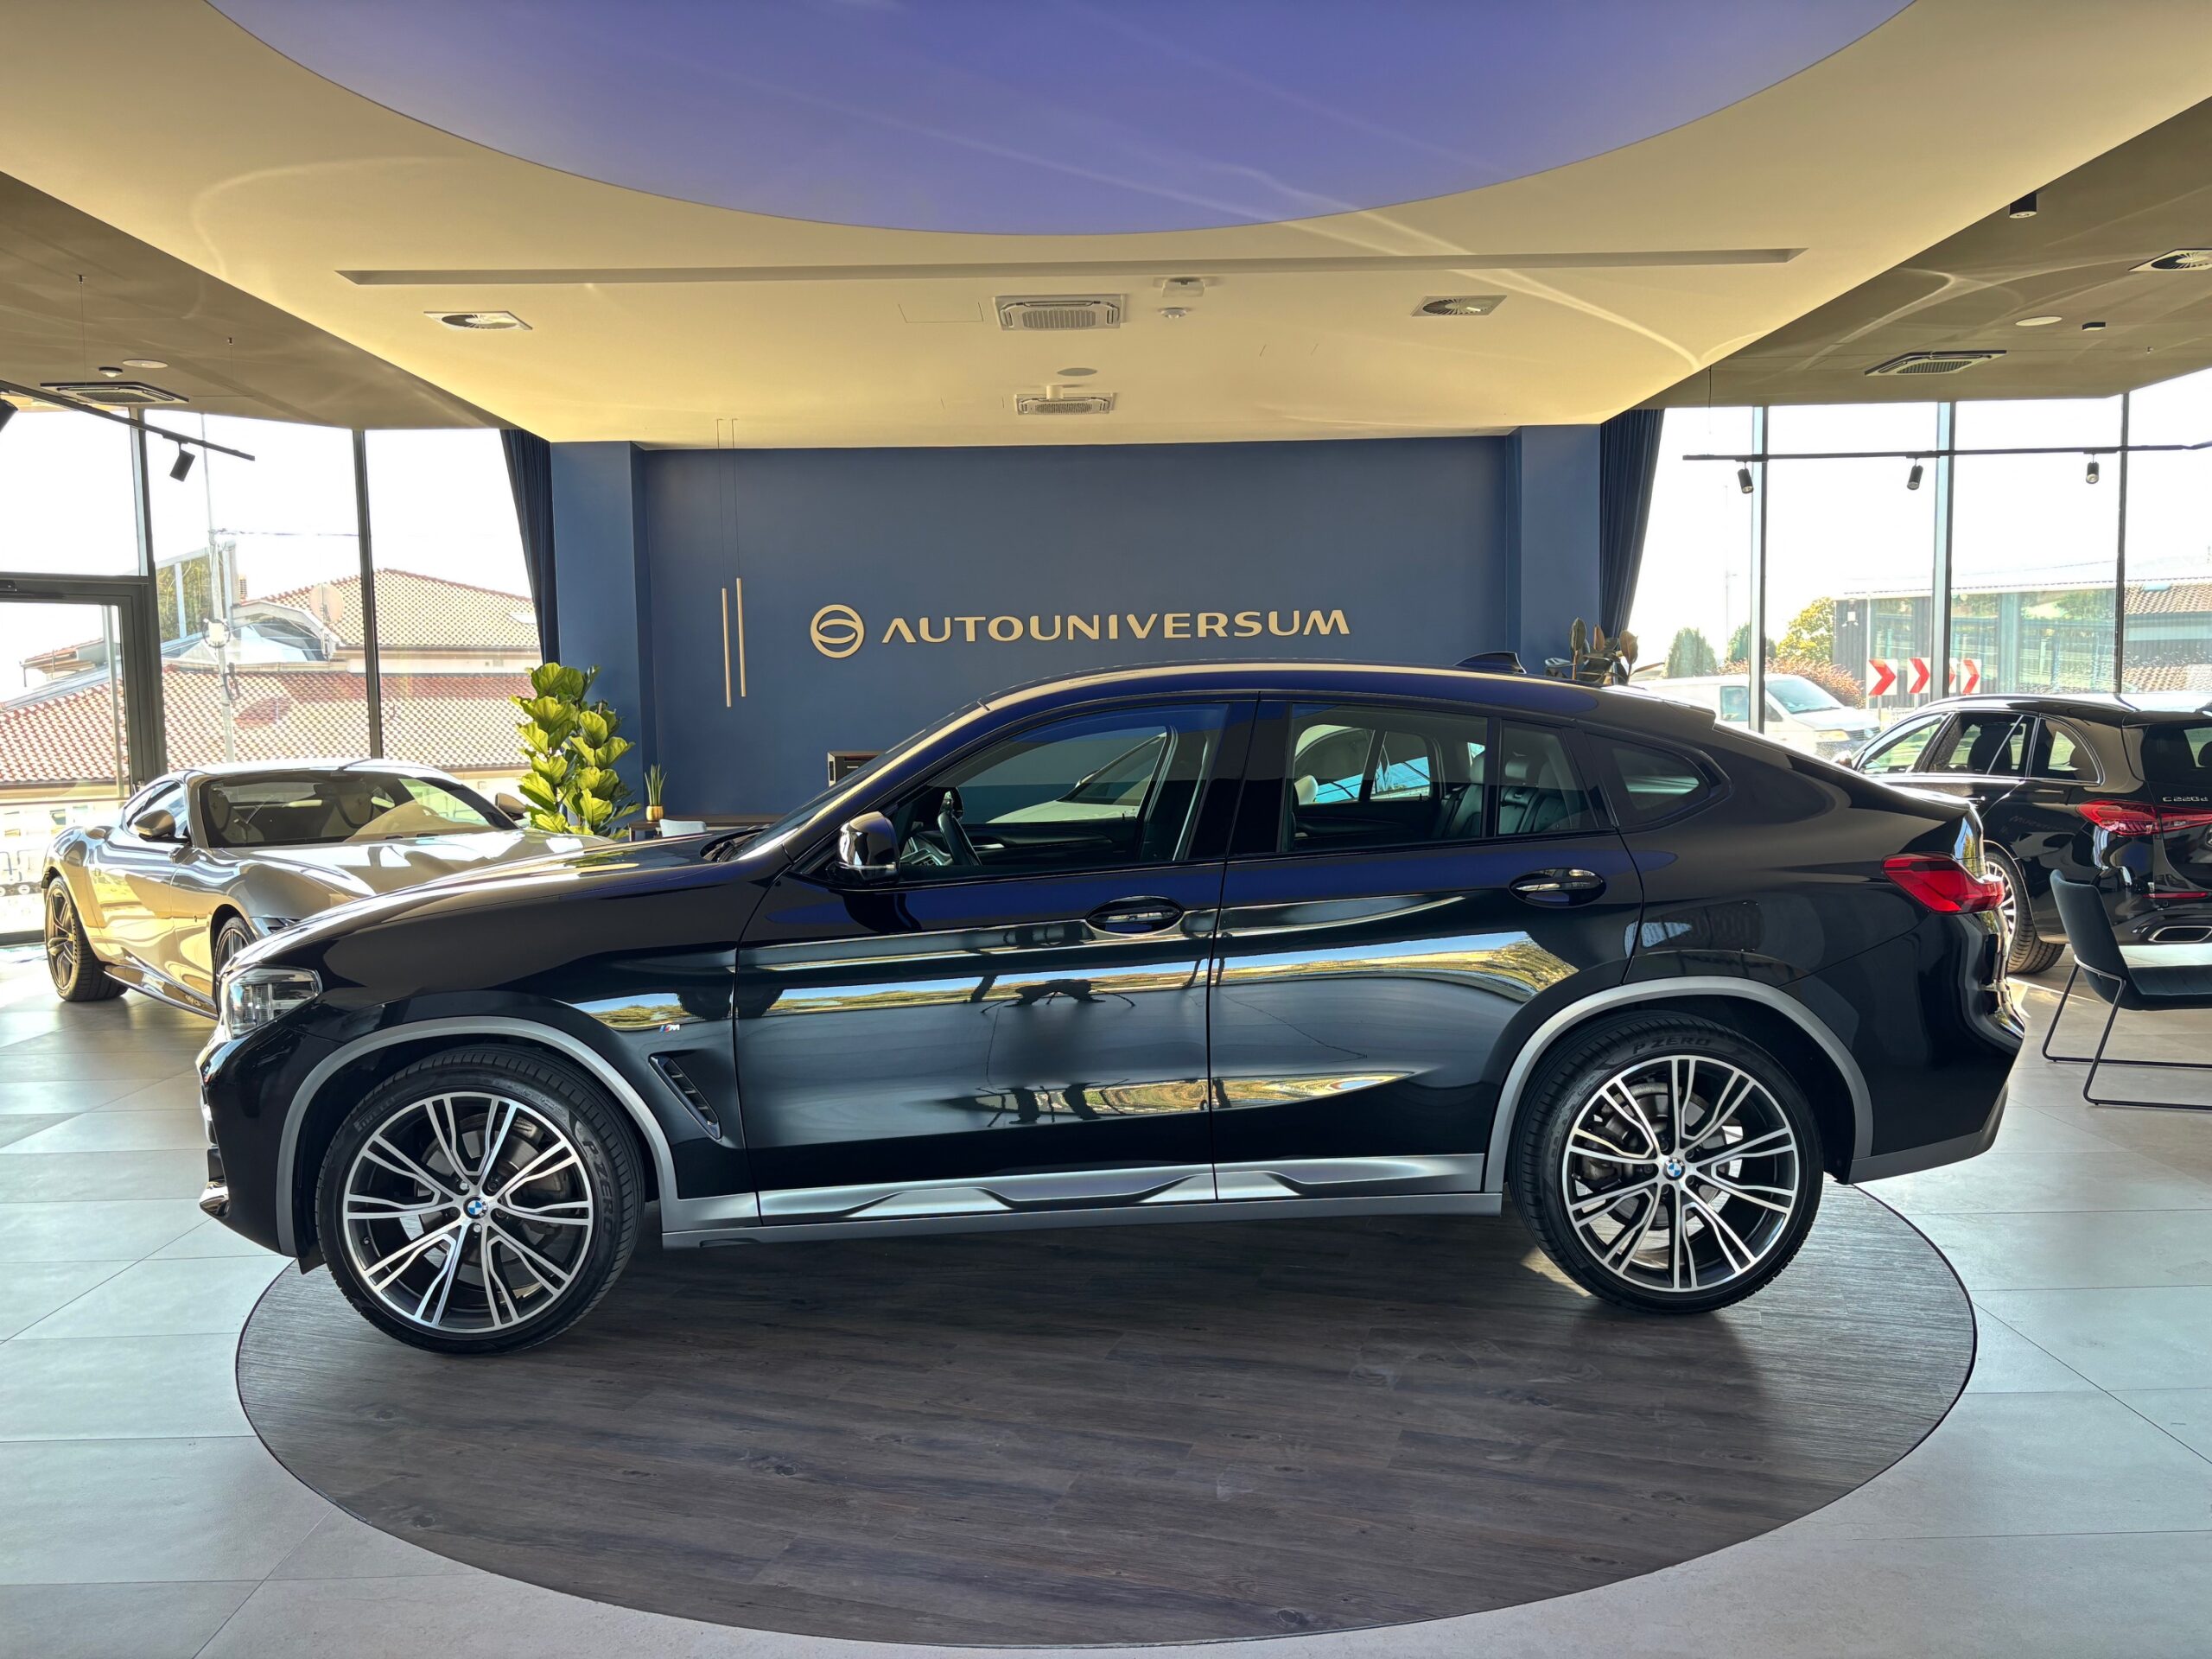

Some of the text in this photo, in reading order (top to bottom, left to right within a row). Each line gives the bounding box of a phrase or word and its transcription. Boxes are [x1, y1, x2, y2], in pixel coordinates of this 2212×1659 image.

[881, 609, 1351, 643] AUTOUNIVERSUM
[1650, 1036, 1711, 1048] ZERO
[582, 1140, 615, 1232] P ZERO
